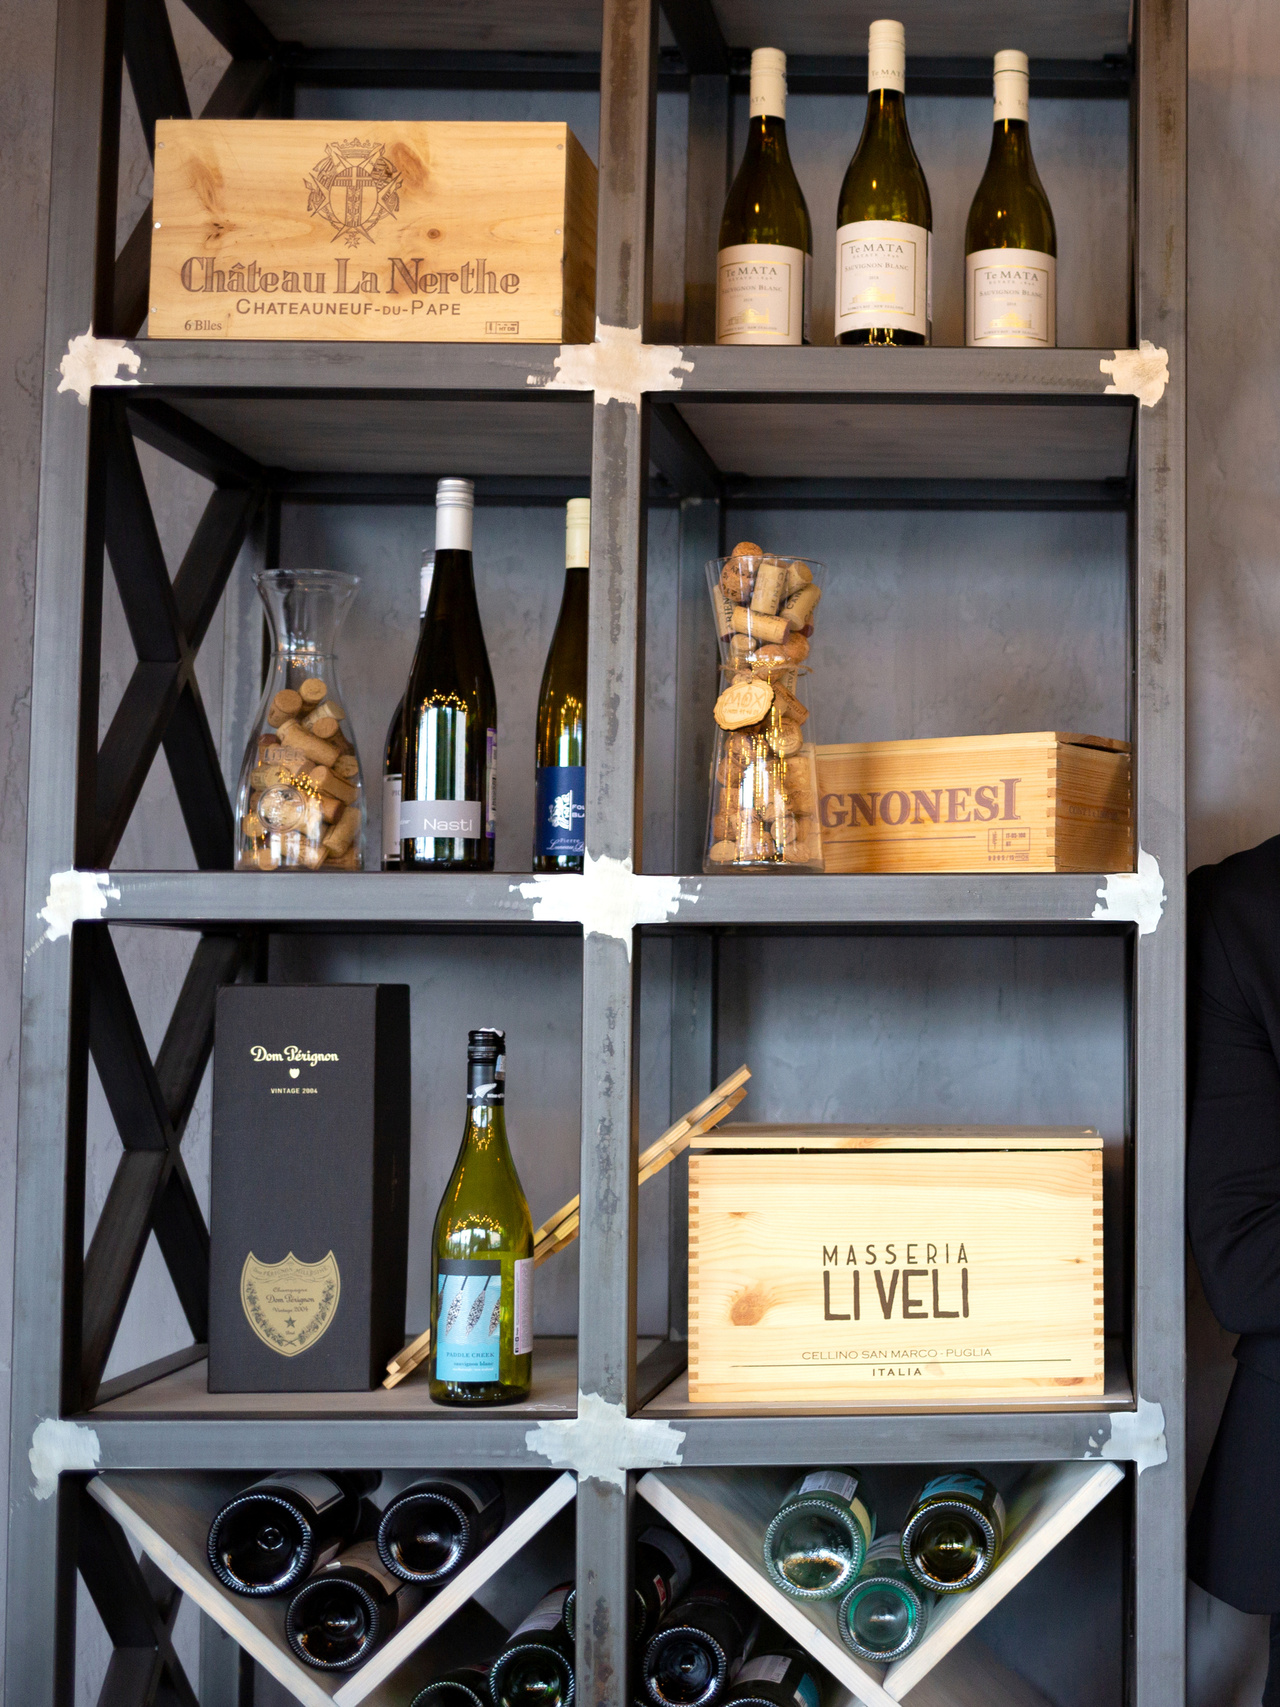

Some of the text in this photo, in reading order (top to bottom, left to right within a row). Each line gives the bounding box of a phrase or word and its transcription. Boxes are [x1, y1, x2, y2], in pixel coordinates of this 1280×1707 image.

[849, 243, 904, 254] Te MATA
[180, 256, 520, 294] Château La Nerthe
[738, 266, 777, 275] MATA
[984, 271, 1039, 282] Te MATA
[184, 319, 222, 331] 6 Blles
[820, 778, 1022, 828] GNONESI
[250, 1045, 340, 1067] Dom Pérignon
[823, 1242, 968, 1266] MASSERIA
[265, 1294, 284, 1304] Dom
[801, 1350, 858, 1360] CELLINO
[861, 1350, 888, 1359] SAN
[890, 1349, 938, 1359] MARCO
[946, 1348, 992, 1357] PUGLIA
[872, 1367, 922, 1377] ITALIA
